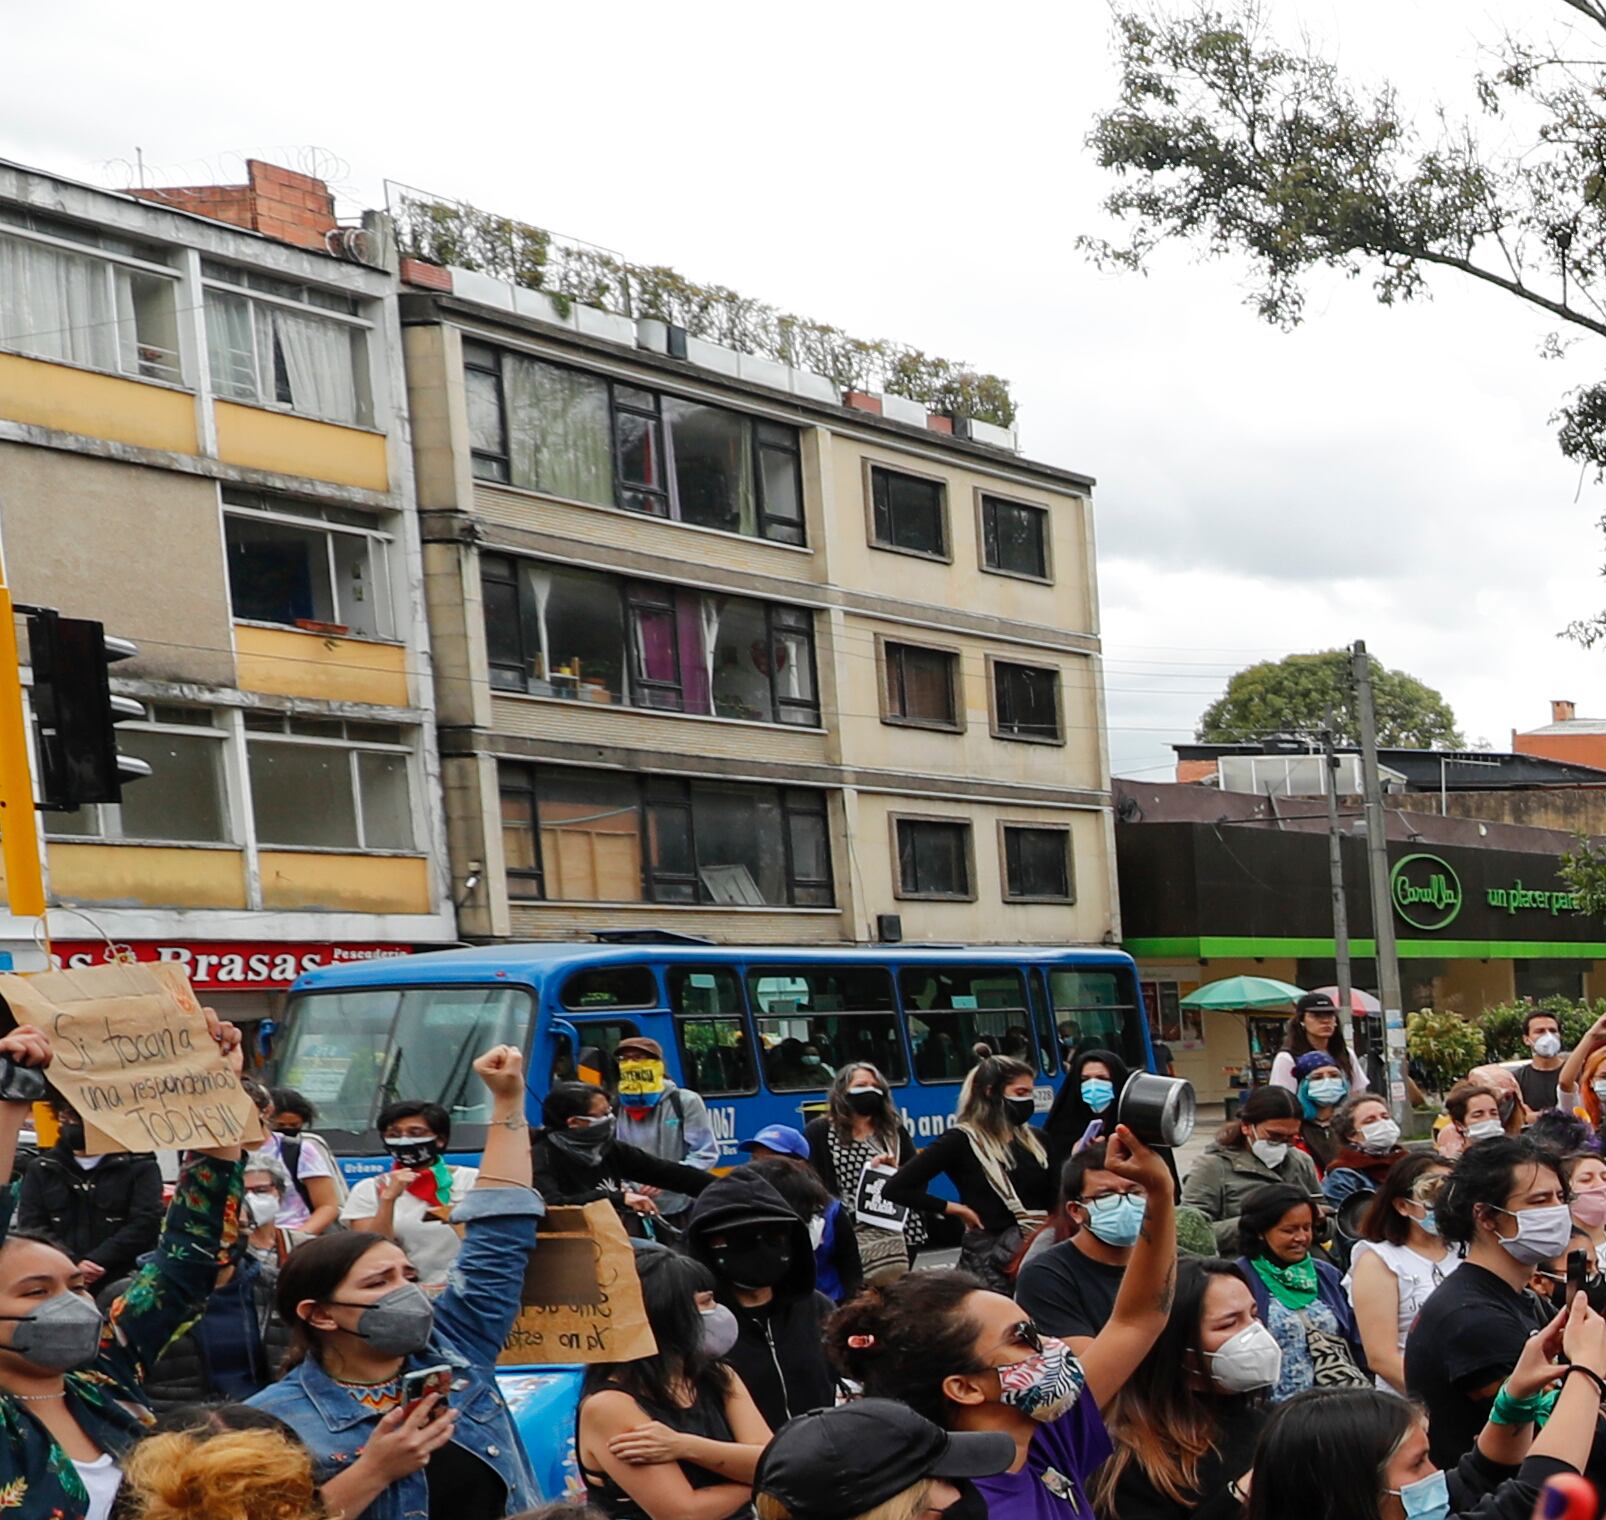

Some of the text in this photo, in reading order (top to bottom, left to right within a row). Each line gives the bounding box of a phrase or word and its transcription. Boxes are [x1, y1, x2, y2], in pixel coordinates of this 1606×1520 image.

[1396, 873, 1457, 910] Carulla
[1509, 878, 1549, 915] placer
[54, 1013, 93, 1071] Si
[80, 1066, 237, 1112] una respondemos
